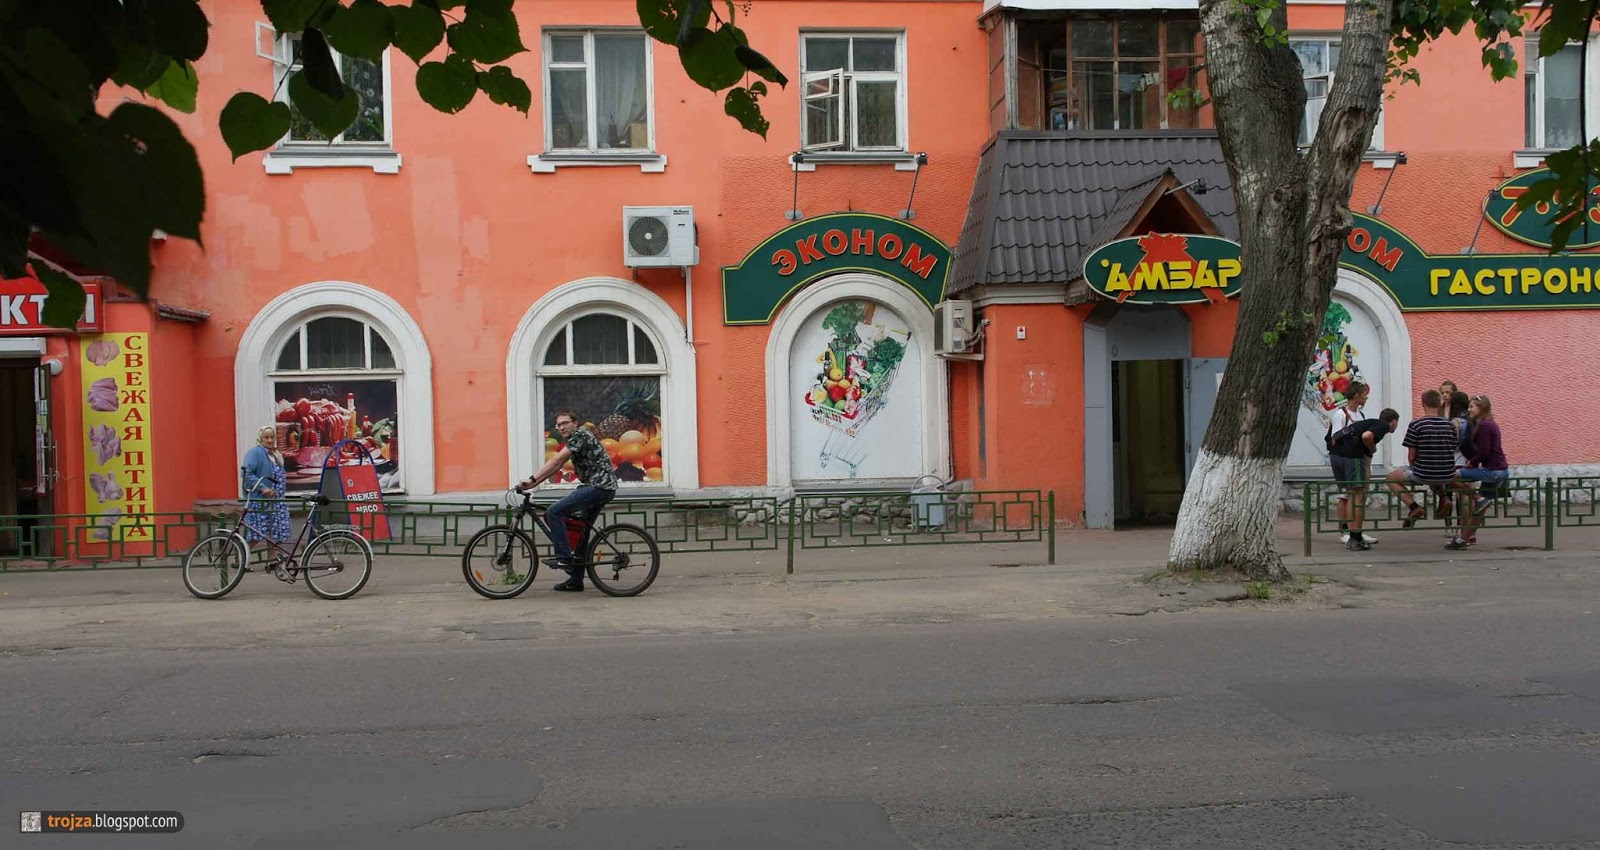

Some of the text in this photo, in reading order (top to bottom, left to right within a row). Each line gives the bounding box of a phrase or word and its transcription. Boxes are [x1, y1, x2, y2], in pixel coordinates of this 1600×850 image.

[772, 229, 938, 279] ЭКОНОМ
[1342, 227, 1404, 272] ОМ
[1103, 258, 1223, 292] АМБАР
[1430, 267, 1600, 296] ГАСТРОН
[121, 335, 148, 538] СВЕЖАЯ ПТИЦА
[346, 491, 379, 501] СВЕЖЕЕ
[356, 504, 378, 513] МЯСО
